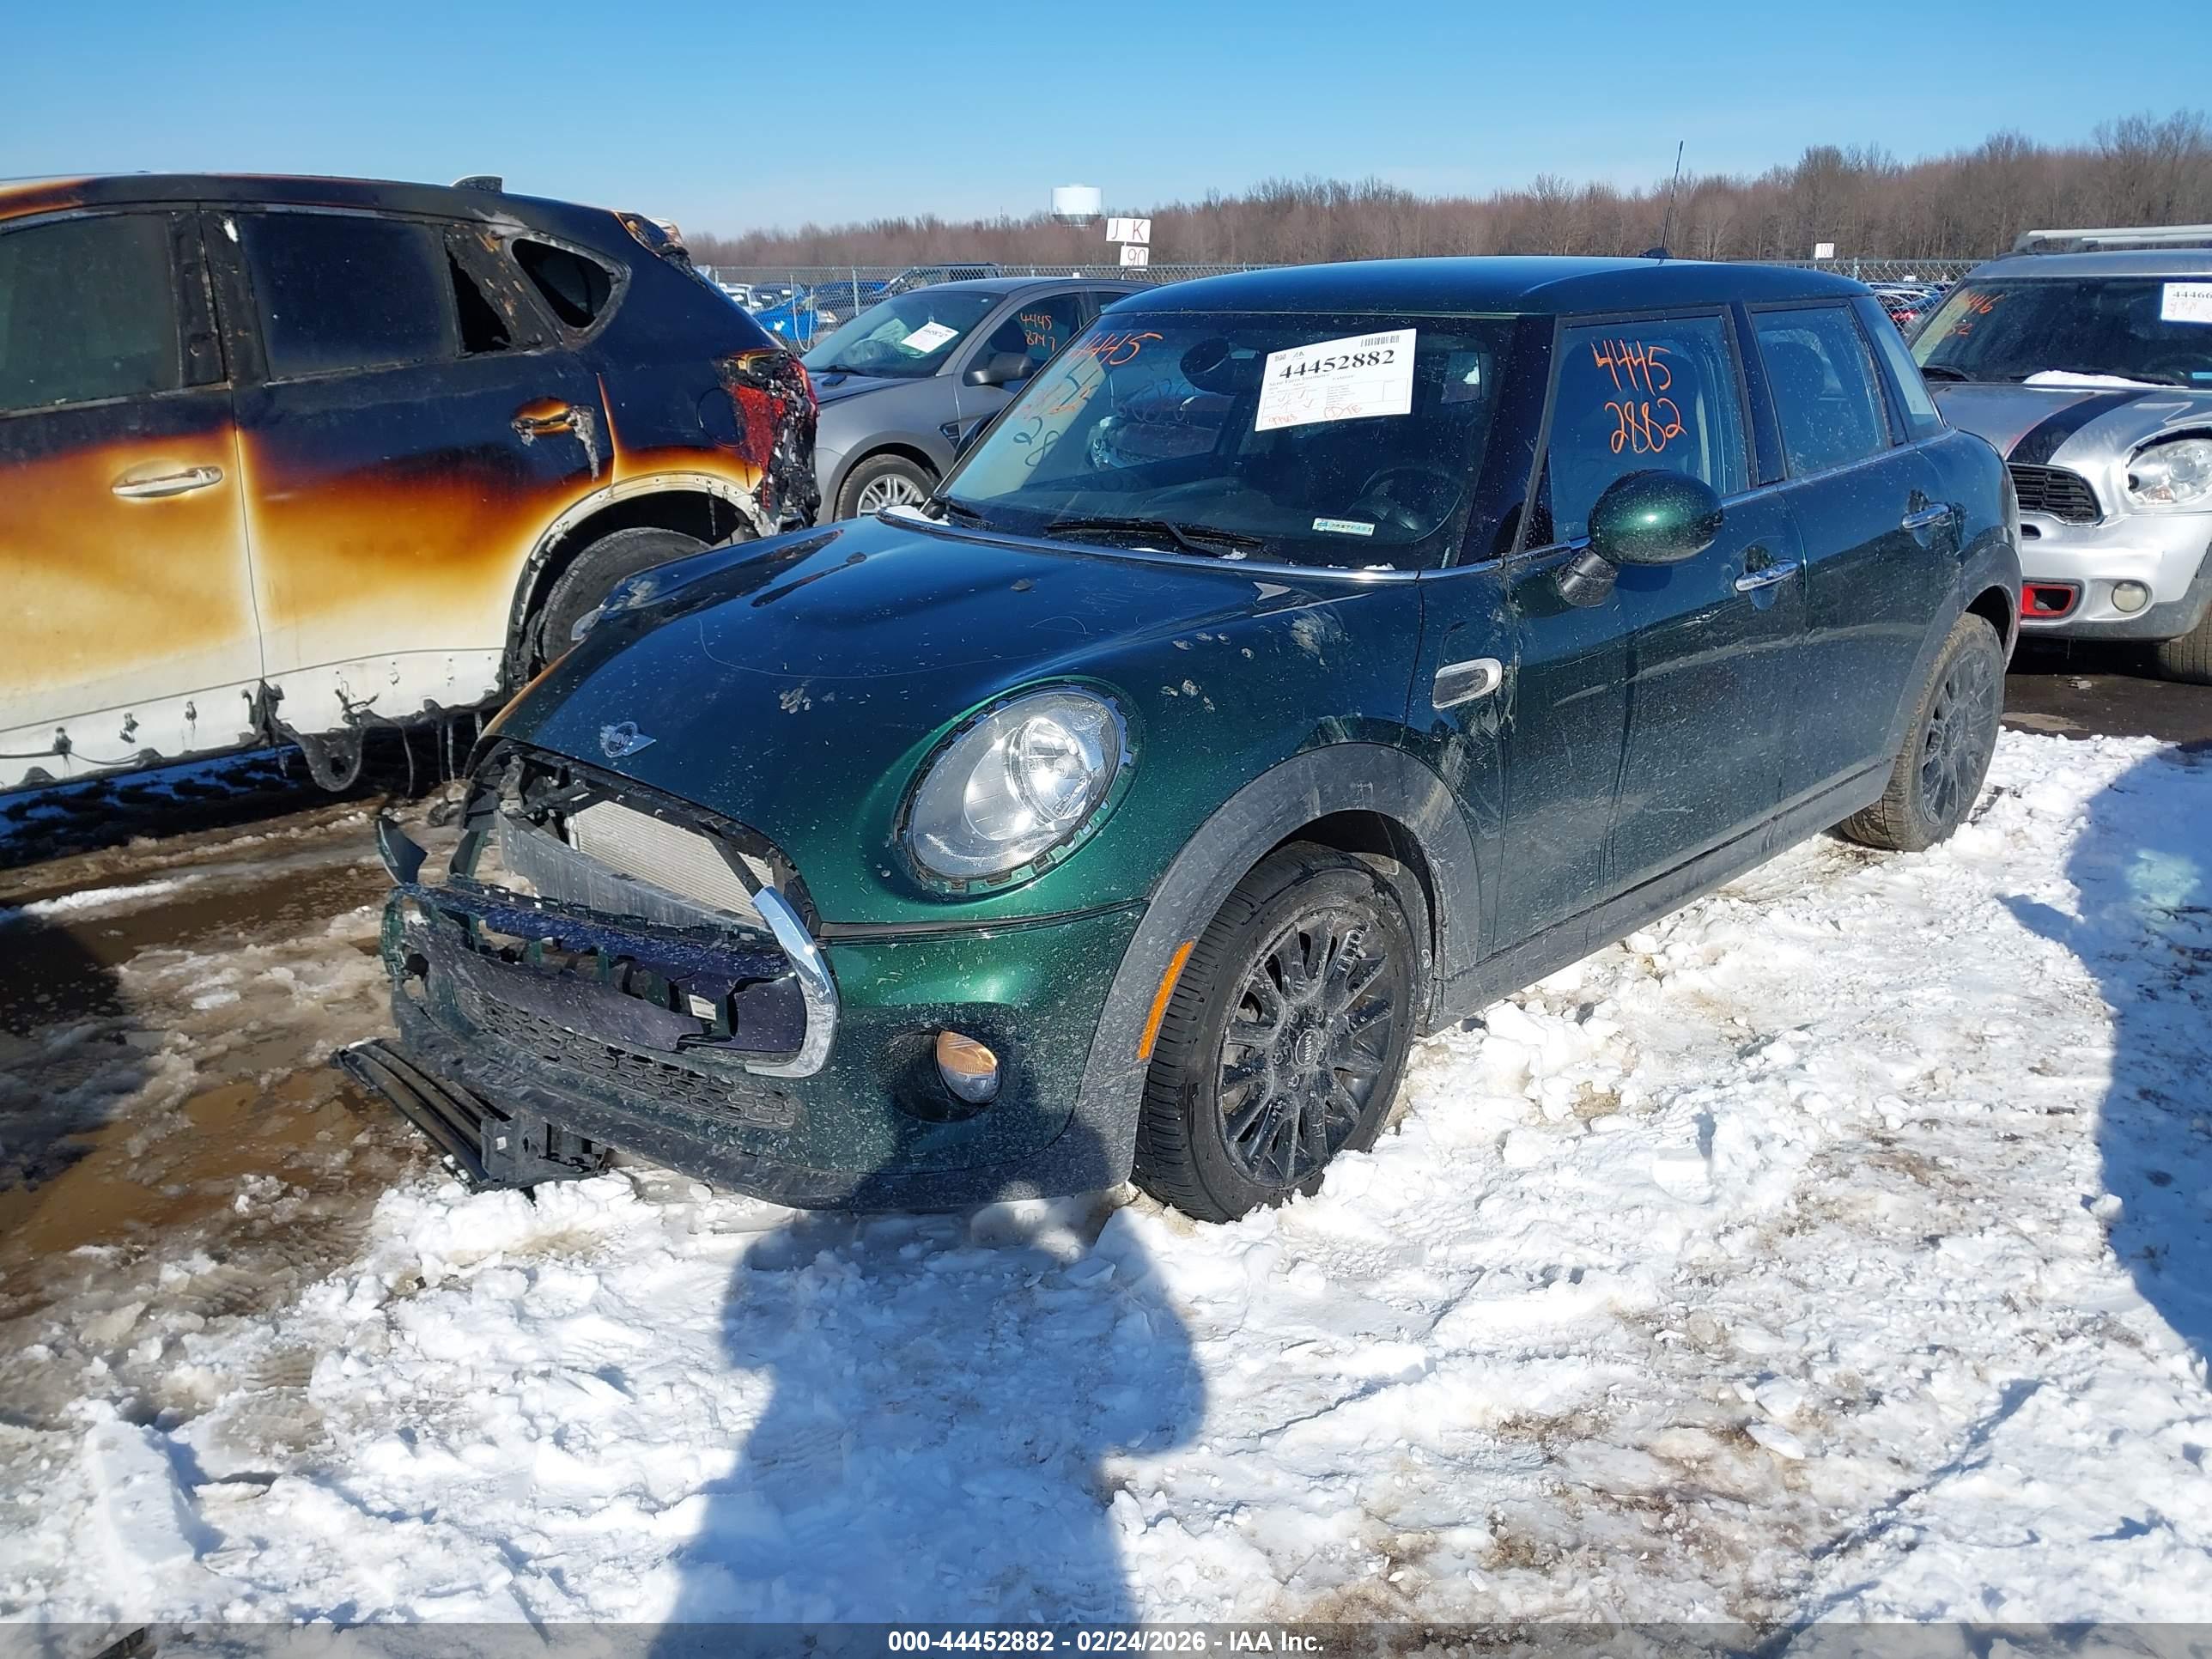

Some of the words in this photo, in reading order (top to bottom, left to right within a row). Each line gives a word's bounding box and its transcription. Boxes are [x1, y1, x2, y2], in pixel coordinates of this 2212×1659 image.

[1111, 220, 1119, 240] J
[1133, 220, 1144, 240] K
[1127, 247, 1146, 266] 90
[1020, 313, 1052, 330] 4445
[1025, 330, 1055, 351] 8747
[1279, 349, 1395, 379] 44452882
[1589, 338, 1672, 397] 4445
[1604, 397, 1688, 454] 2882
